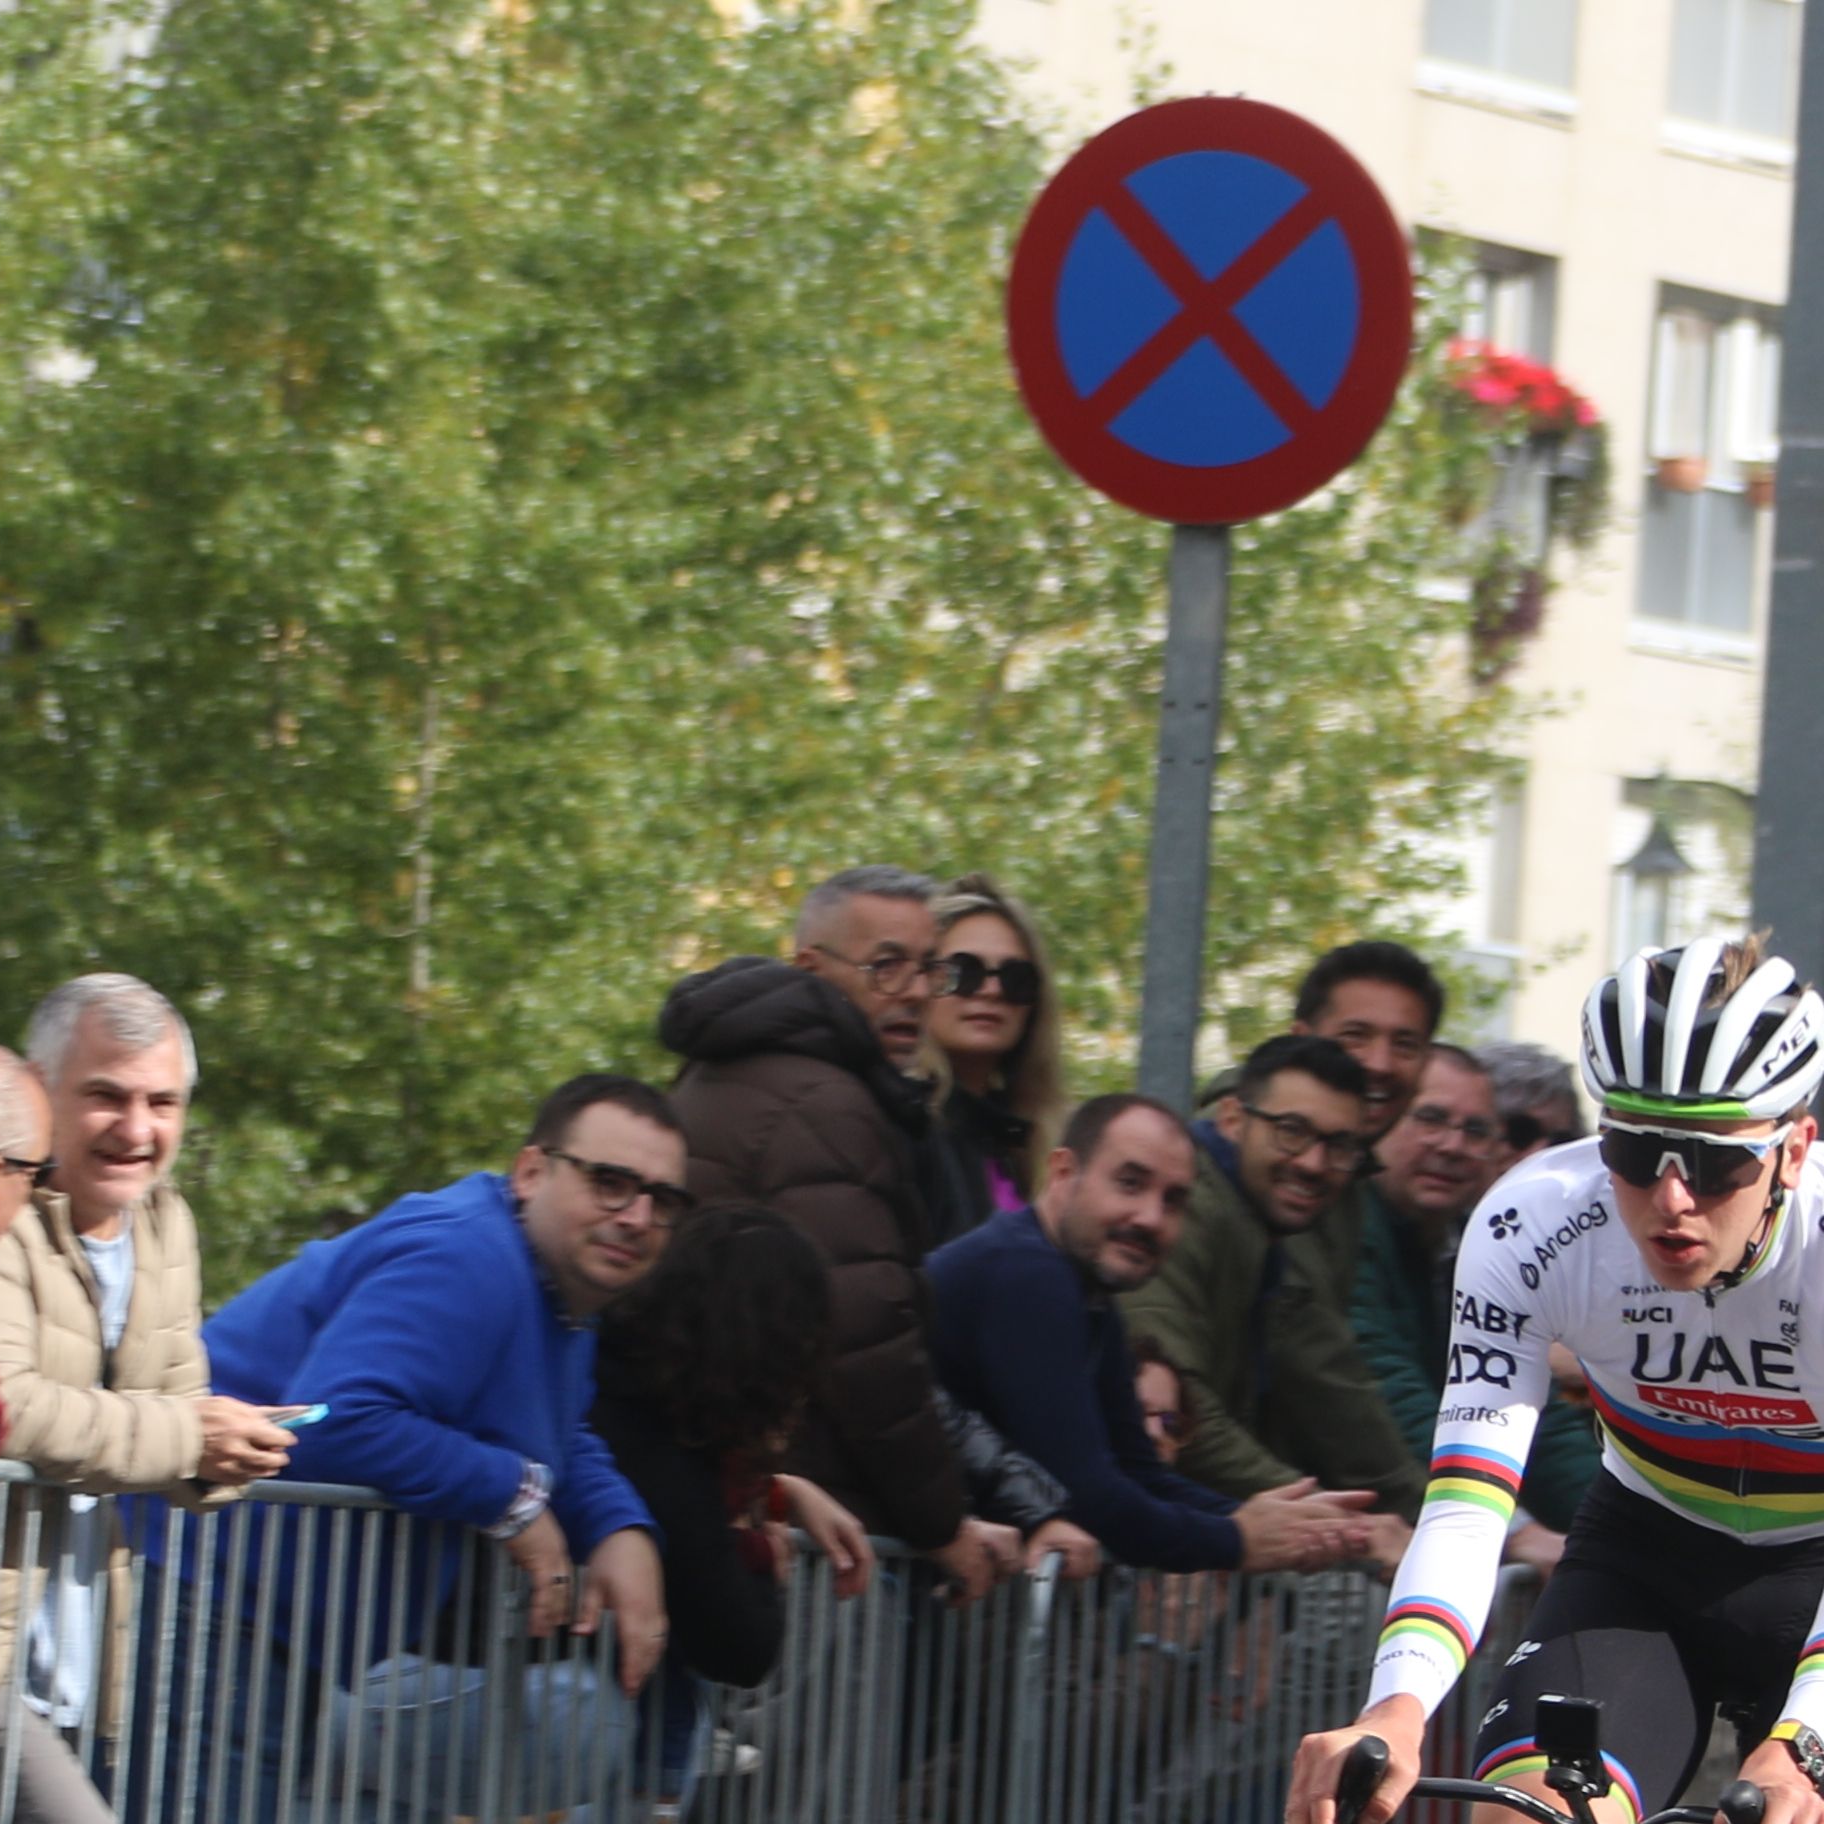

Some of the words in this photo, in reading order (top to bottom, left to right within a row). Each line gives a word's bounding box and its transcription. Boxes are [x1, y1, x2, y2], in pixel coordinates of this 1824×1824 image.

[1761, 1013, 1811, 1077] MET
[1534, 1200, 1609, 1272] Analog
[1454, 1289, 1508, 1334] FAB
[1631, 1307, 1673, 1323] UCI
[1631, 1332, 1801, 1393] UAE
[1654, 1389, 1797, 1424] Emirates
